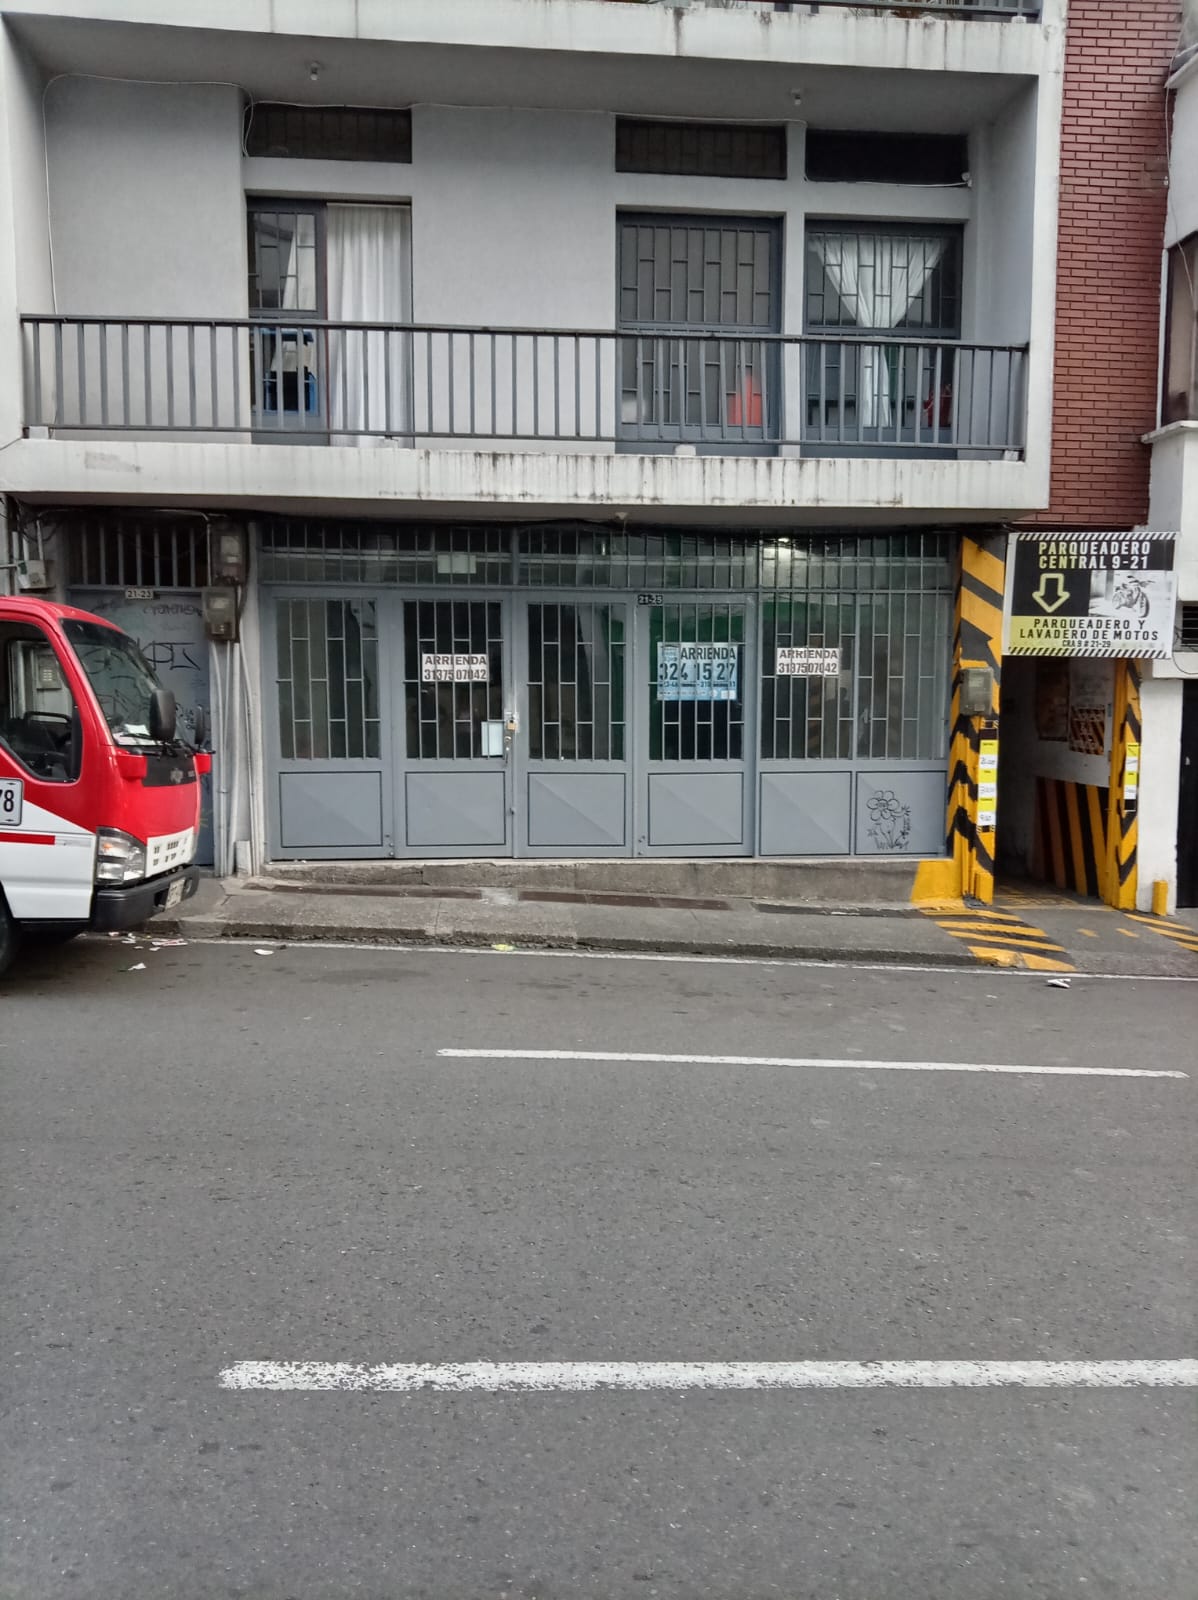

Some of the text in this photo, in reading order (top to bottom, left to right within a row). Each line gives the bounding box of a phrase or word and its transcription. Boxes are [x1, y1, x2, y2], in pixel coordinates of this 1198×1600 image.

[1038, 541, 1151, 555] PARQUEADERO
[1038, 555, 1149, 569] CENTRAL 9-21
[127, 590, 153, 598] 21-23
[1033, 618, 1146, 630] PARQUEADERO Y
[1019, 629, 1159, 641] LAVADERO DE MOTOS
[680, 647, 736, 660] ARRIENDA
[779, 649, 838, 659] ARRIENDA
[424, 655, 487, 665] ARRIENDA
